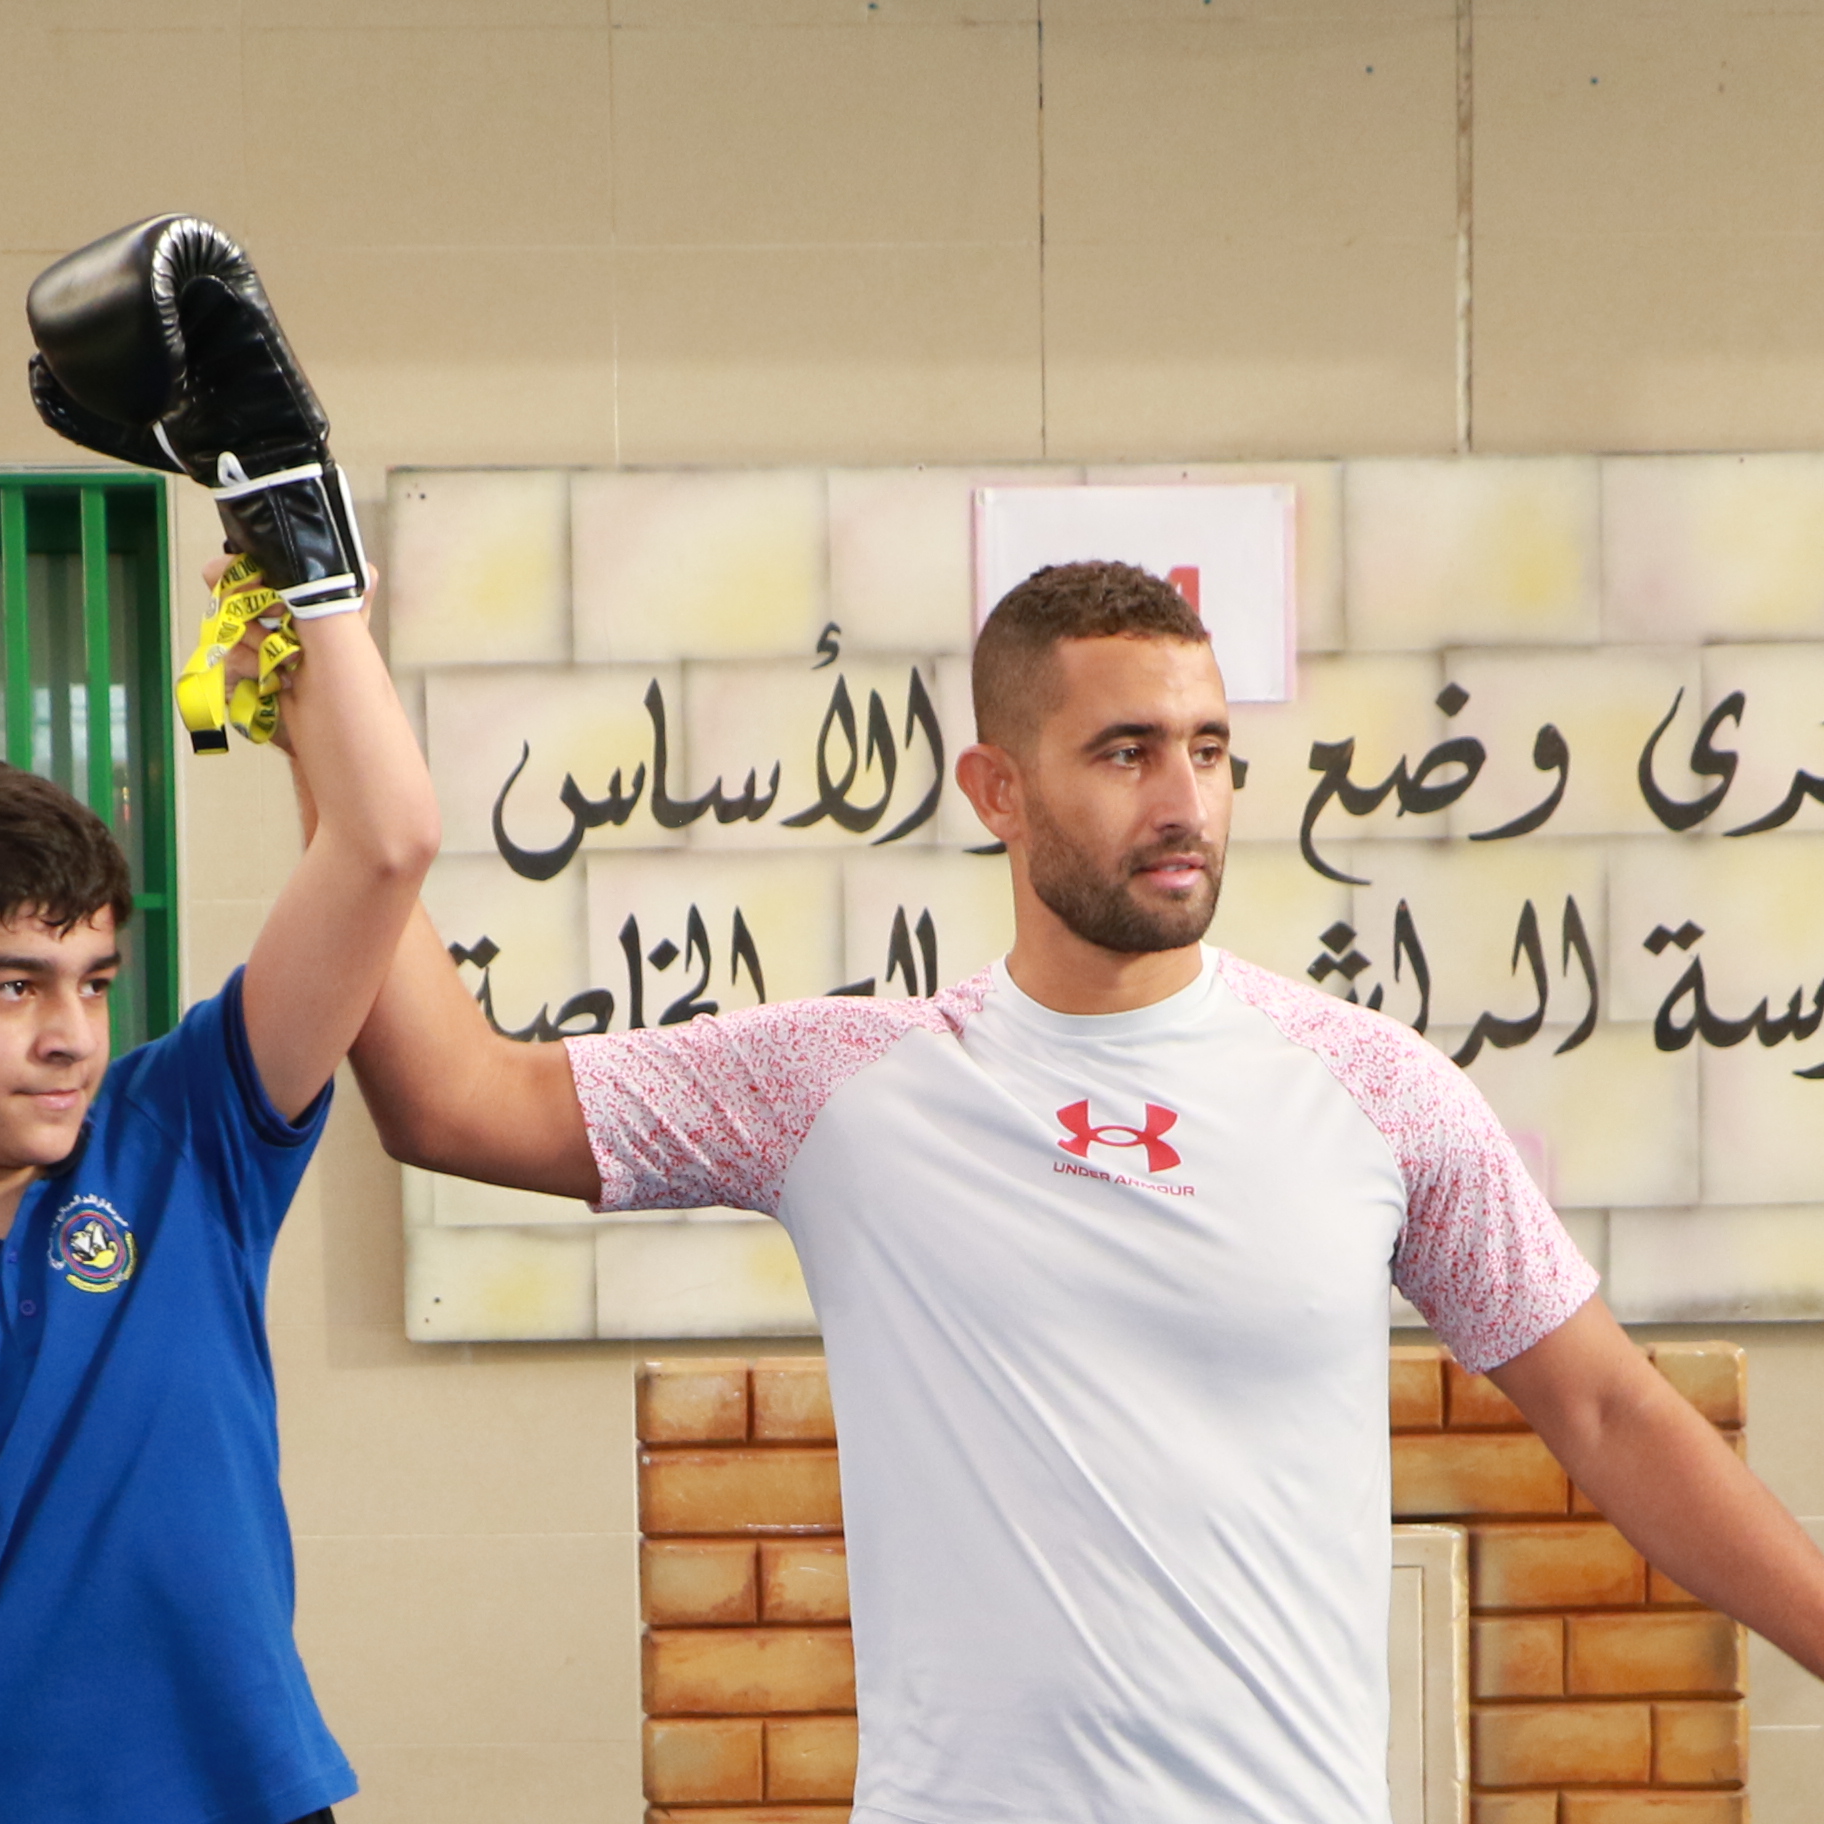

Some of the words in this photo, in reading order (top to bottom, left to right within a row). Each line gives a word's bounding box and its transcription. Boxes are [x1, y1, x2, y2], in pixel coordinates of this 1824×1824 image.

[491, 620, 946, 881] الأساس
[1300, 681, 1569, 886] وضع
[1306, 894, 1599, 1069] الراش
[1053, 1161, 1111, 1183] UNDER
[1114, 1174, 1195, 1197] ARMOUR
